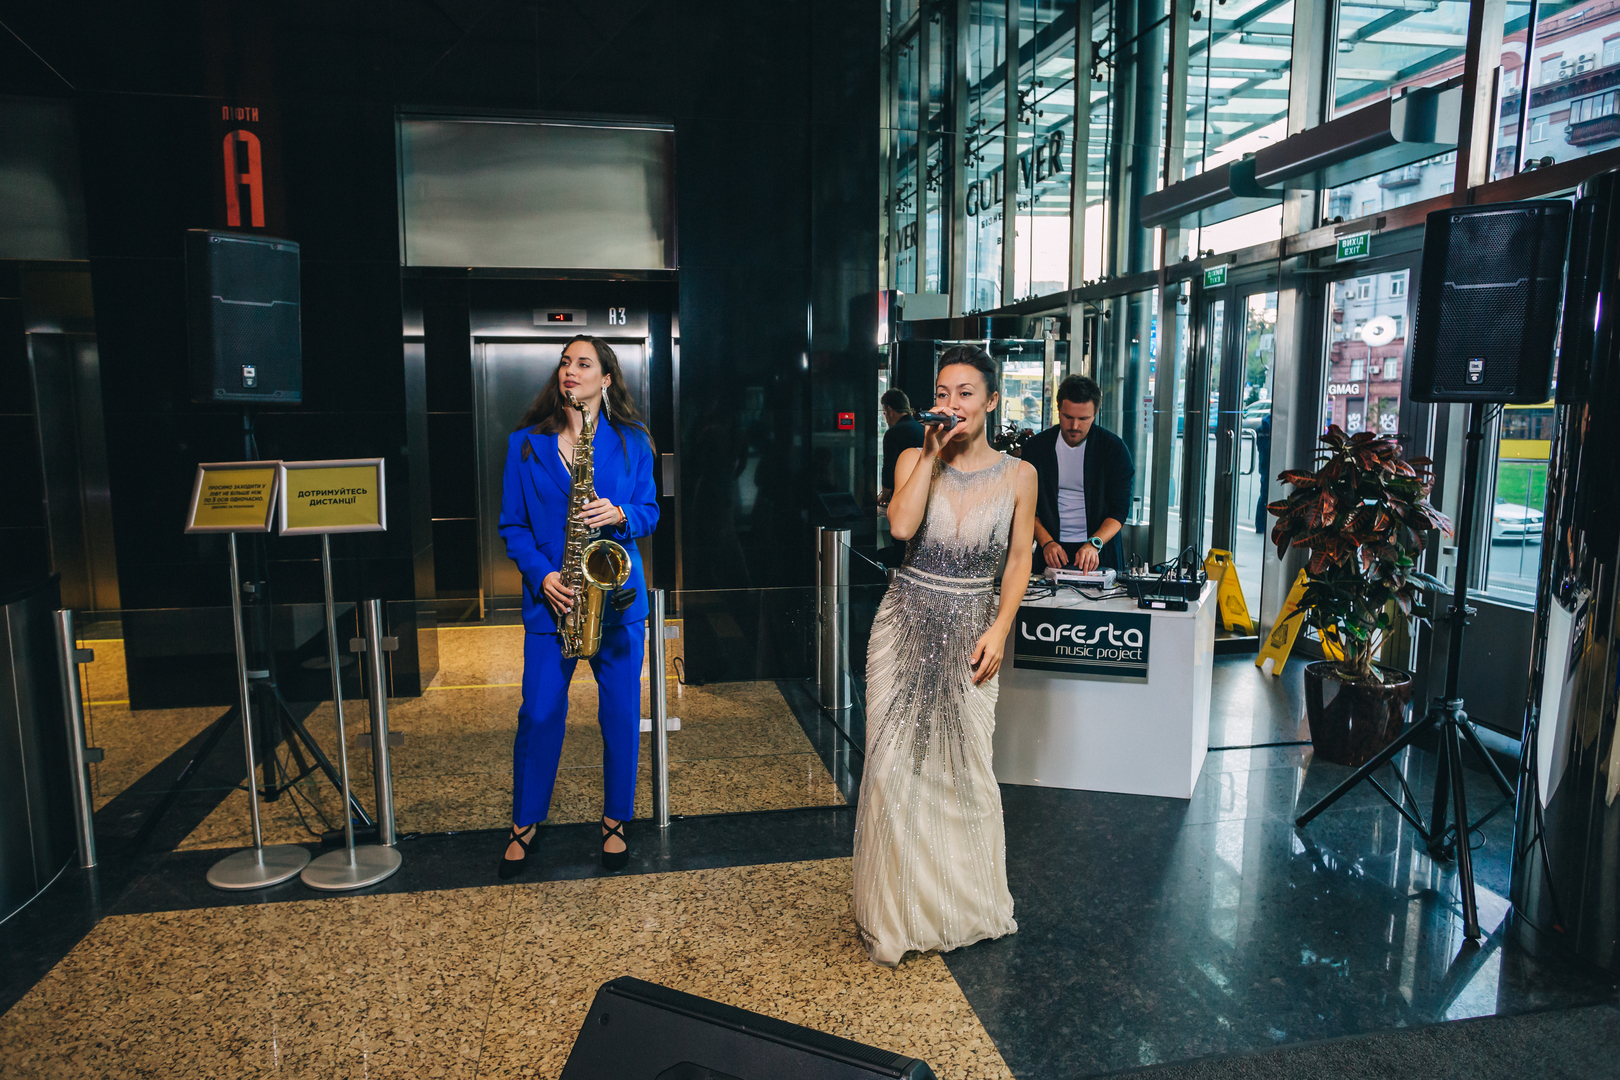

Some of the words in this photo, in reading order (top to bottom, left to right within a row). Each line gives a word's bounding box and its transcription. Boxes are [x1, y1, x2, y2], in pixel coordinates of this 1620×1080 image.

[1341, 236, 1364, 248] ВИХІД
[1344, 246, 1361, 256] EXIT
[1328, 383, 1360, 395] GMAG
[297, 487, 368, 498] ДОТРИМУЙТЕСЬ
[309, 496, 357, 507] ДИСТАНЦІЇ
[1055, 645, 1094, 657] music
[1096, 647, 1143, 661] project
